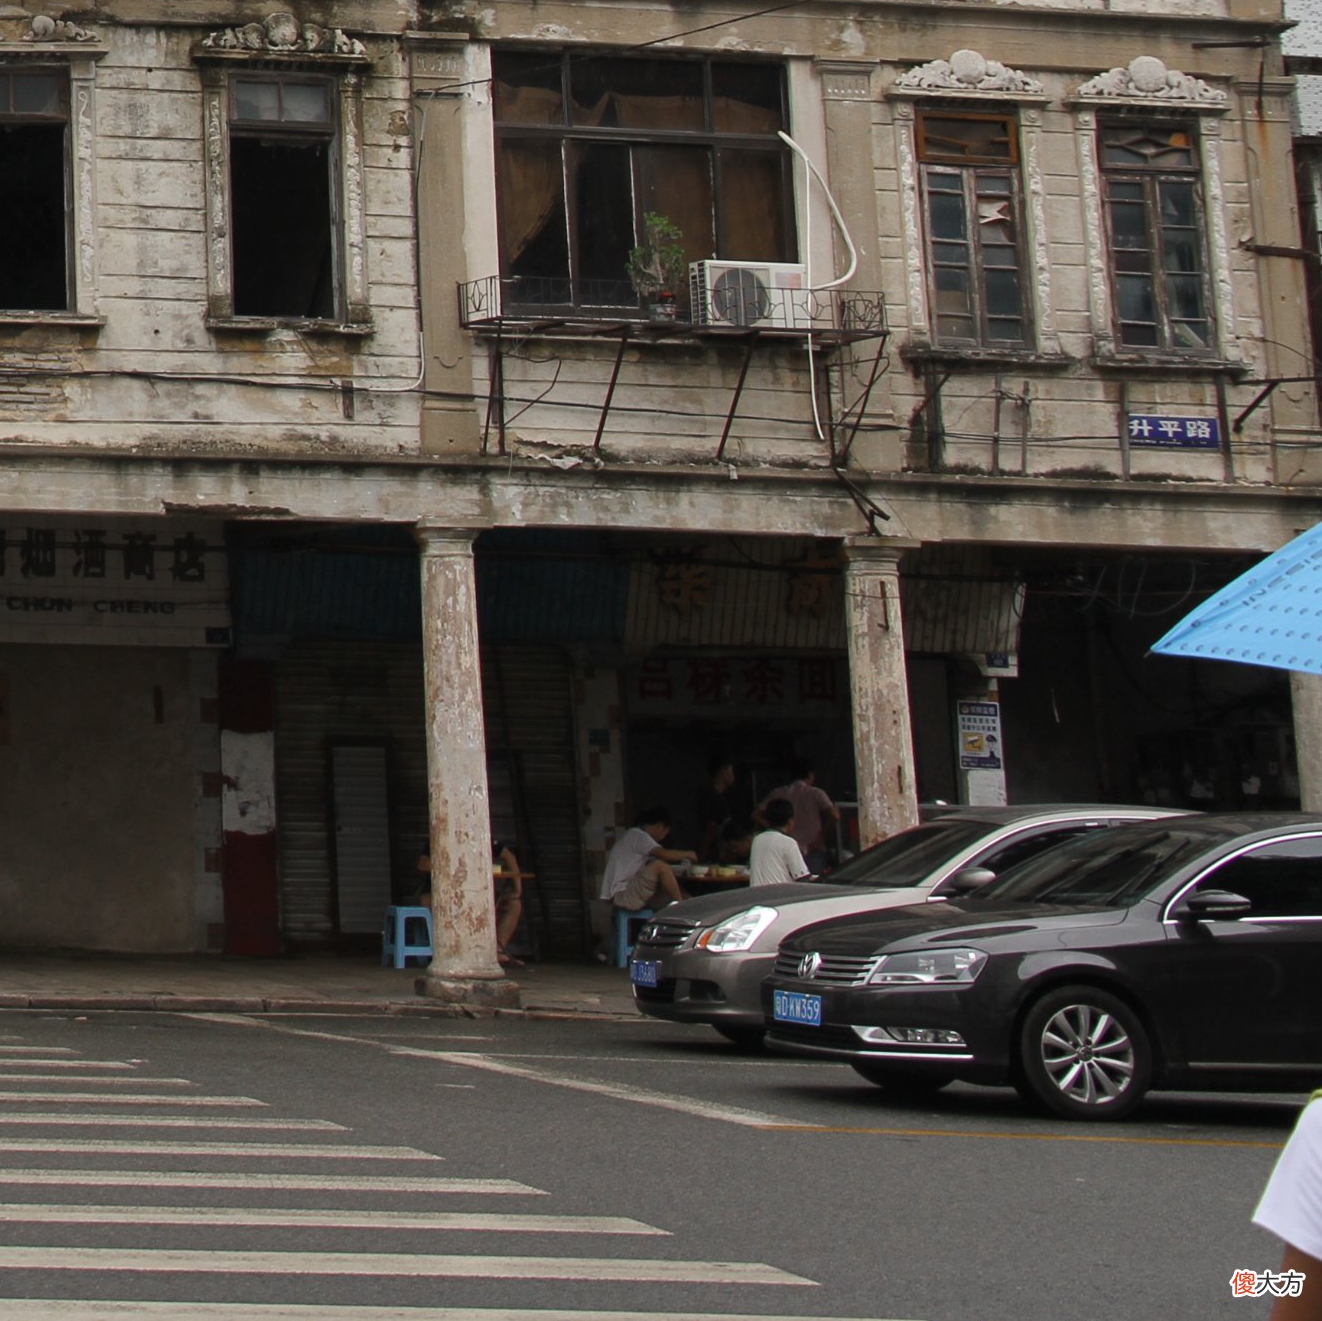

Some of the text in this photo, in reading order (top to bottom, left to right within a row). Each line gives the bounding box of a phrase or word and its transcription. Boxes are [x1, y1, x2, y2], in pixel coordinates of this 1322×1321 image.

[1128, 419, 1211, 438] 升平路
[93, 600, 176, 614] CHENG
